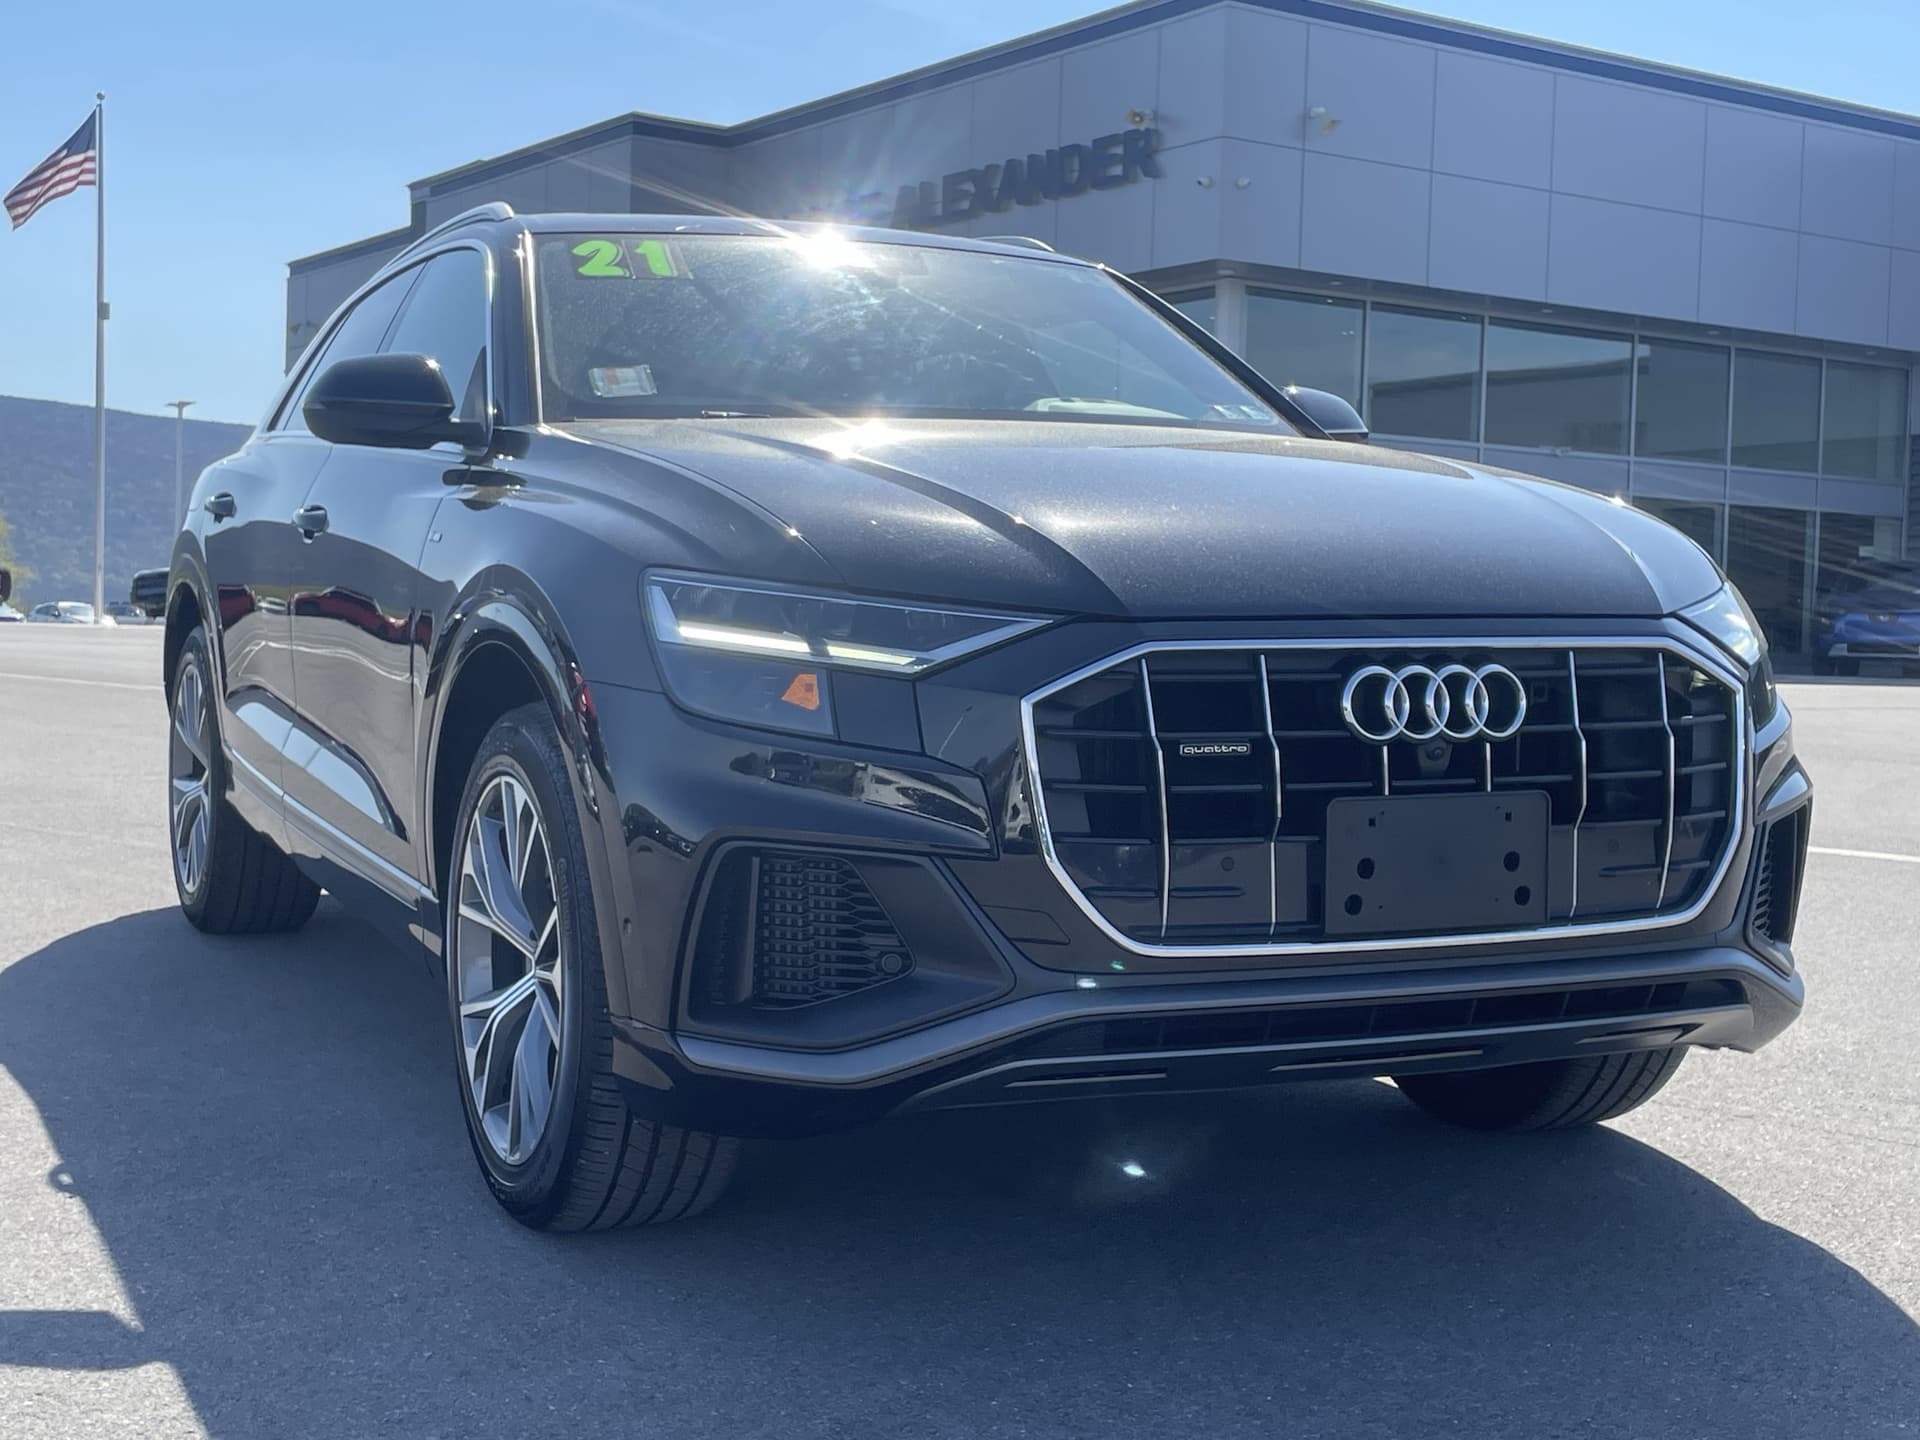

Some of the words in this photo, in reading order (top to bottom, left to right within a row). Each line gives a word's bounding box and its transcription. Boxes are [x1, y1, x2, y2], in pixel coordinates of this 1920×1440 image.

[891, 127, 1164, 229] ALEXANDER
[571, 239, 675, 277] 21
[1183, 744, 1248, 755] quattro
